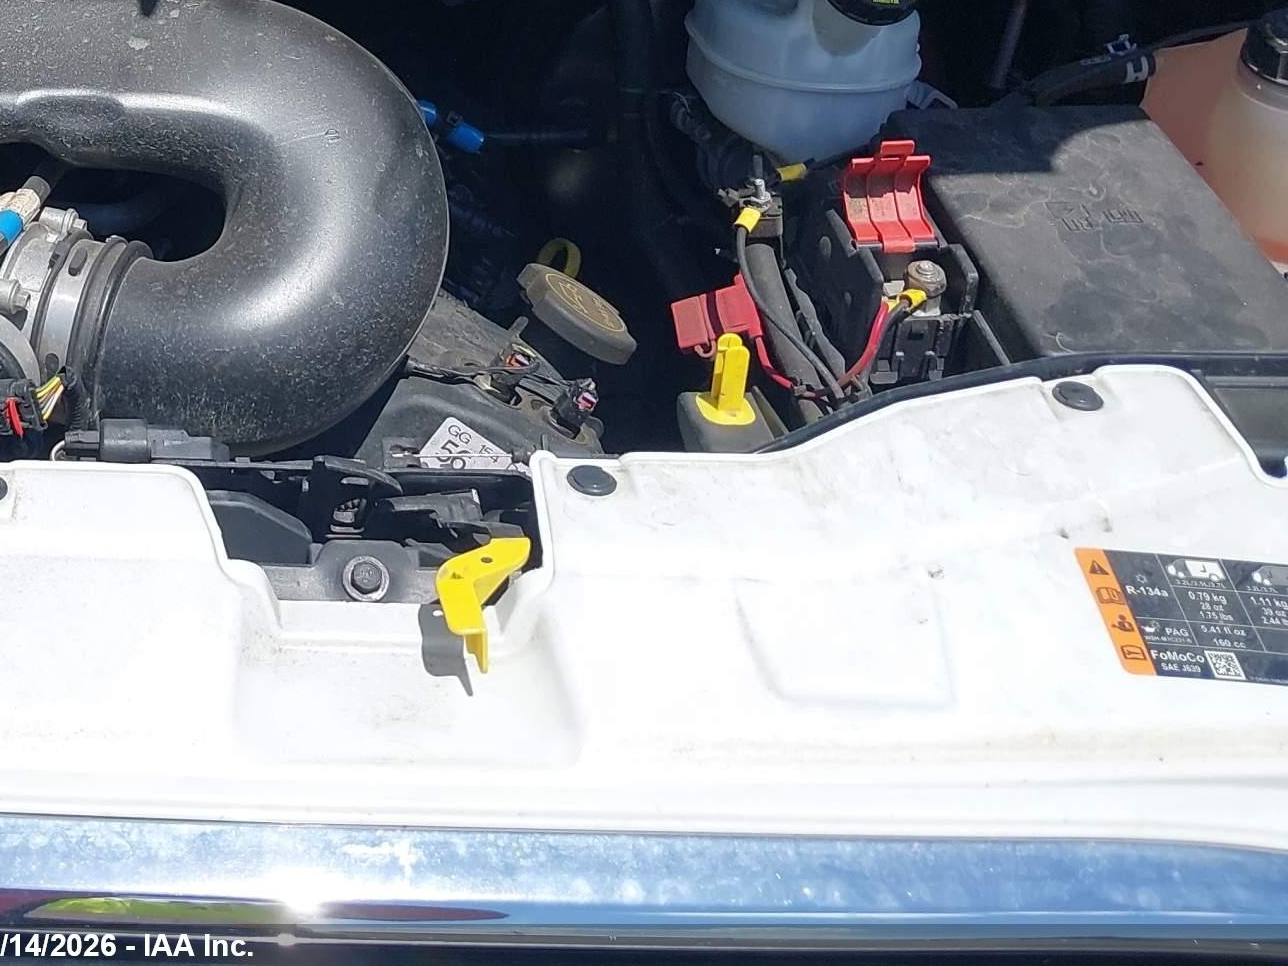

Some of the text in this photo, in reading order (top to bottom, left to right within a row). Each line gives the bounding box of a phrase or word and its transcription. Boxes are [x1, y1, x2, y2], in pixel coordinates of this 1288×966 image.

[448, 424, 472, 445] GG
[1125, 584, 1169, 598] R-134a
[1188, 591, 1228, 605] 0.79 kg
[1250, 596, 1272, 606] 1.11
[1199, 611, 1218, 620] 1.75
[1165, 627, 1189, 637] PAG
[1201, 624, 1221, 634] 5.41
[1233, 628, 1247, 636] oz
[1213, 638, 1231, 648] 160
[1150, 649, 1205, 663] FoMoCo
[1161, 662, 1179, 671] SAE
